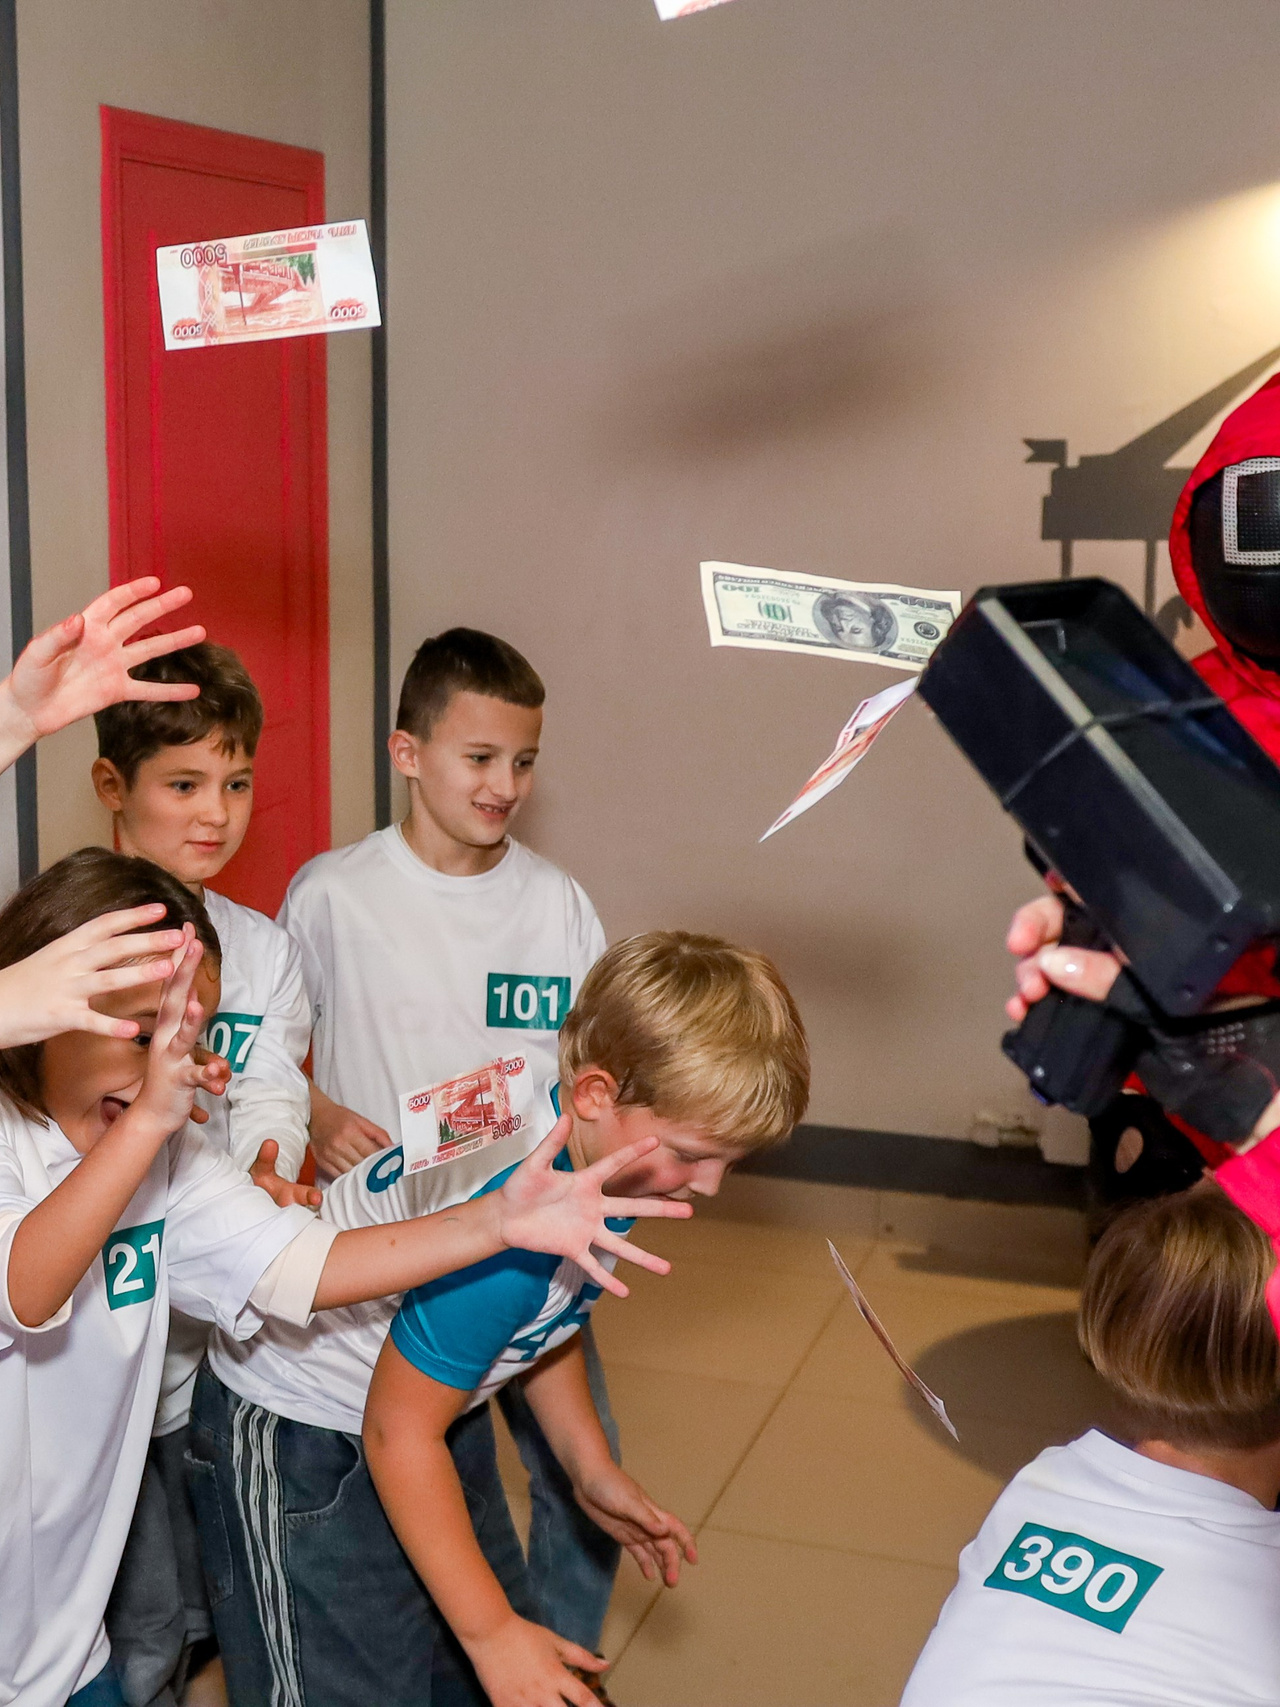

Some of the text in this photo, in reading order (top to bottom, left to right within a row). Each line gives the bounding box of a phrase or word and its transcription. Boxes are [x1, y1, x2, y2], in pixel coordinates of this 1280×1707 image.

[180, 243, 227, 269] 5000
[330, 303, 366, 319] 5000
[173, 323, 203, 339] 5000
[493, 982, 559, 1021] 101
[502, 1058, 525, 1074] 5000
[408, 1094, 431, 1110] 5000
[491, 1114, 522, 1140] 5000
[108, 1233, 160, 1296] 21
[1003, 1535, 1139, 1613] 390
